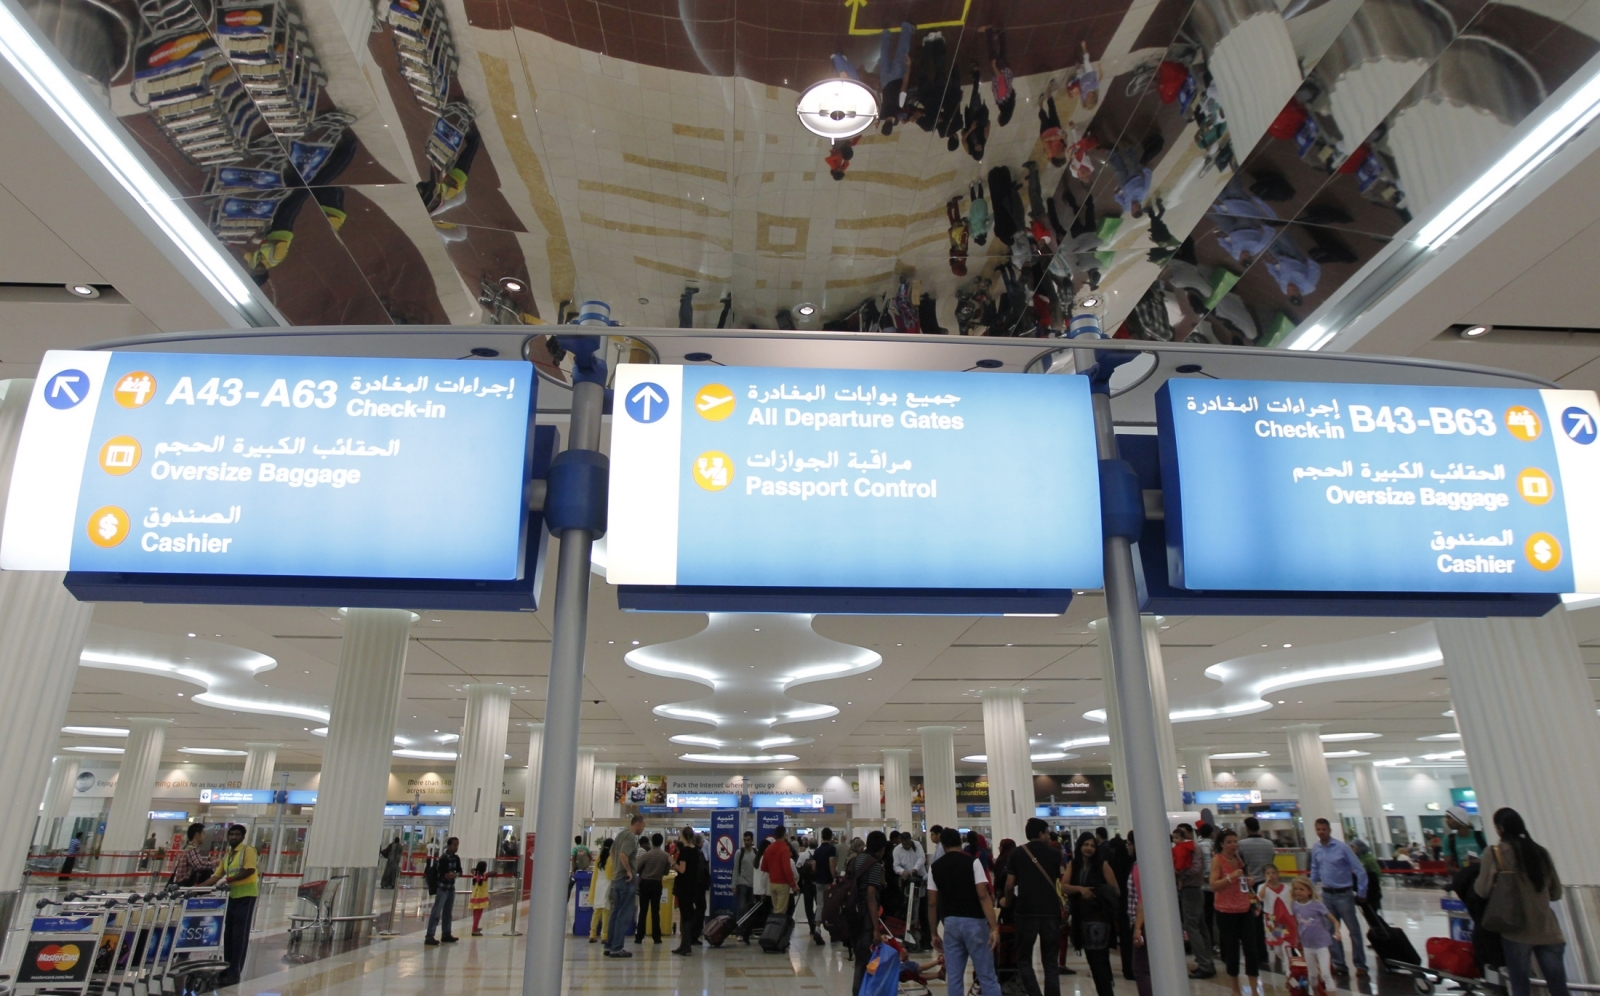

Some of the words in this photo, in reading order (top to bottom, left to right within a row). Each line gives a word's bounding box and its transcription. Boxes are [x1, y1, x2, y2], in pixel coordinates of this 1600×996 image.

[165, 377, 338, 408] A43-A63
[350, 375, 428, 394] المغادرة
[435, 377, 514, 398] إجراءات
[748, 384, 825, 403] المغادرة
[835, 386, 897, 406] بوابات
[906, 393, 961, 409] جميع
[1187, 396, 1258, 413] المغادرة
[347, 399, 445, 418] Check-in
[748, 408, 777, 425] All
[785, 408, 894, 430] Departure
[901, 411, 964, 429] Gates
[1267, 398, 1340, 419] إجراءات
[1255, 419, 1345, 439] Check-in
[1349, 405, 1497, 436] B43-B63
[155, 435, 224, 458] الحجم
[233, 437, 305, 458] الكبيرة
[313, 438, 400, 460] الحقائب
[747, 450, 838, 472] الجوازات
[848, 450, 912, 474] مراقبة
[1293, 461, 1353, 482] الحجم
[151, 461, 252, 481] Oversize
[259, 463, 360, 488] Baggage
[1361, 462, 1423, 482] الكبيرة
[1431, 463, 1505, 484] الحقائب
[747, 476, 848, 500] Passport
[854, 478, 936, 497] Control
[1326, 486, 1415, 505] Oversize
[1420, 488, 1509, 511] Baggage
[144, 506, 241, 528] الصندوق
[142, 532, 232, 552] Cashier
[1431, 530, 1513, 550] الصندوق
[1437, 554, 1515, 573] Cashier
[173, 780, 188, 788] calls
[37, 953, 79, 962] MasterCard
